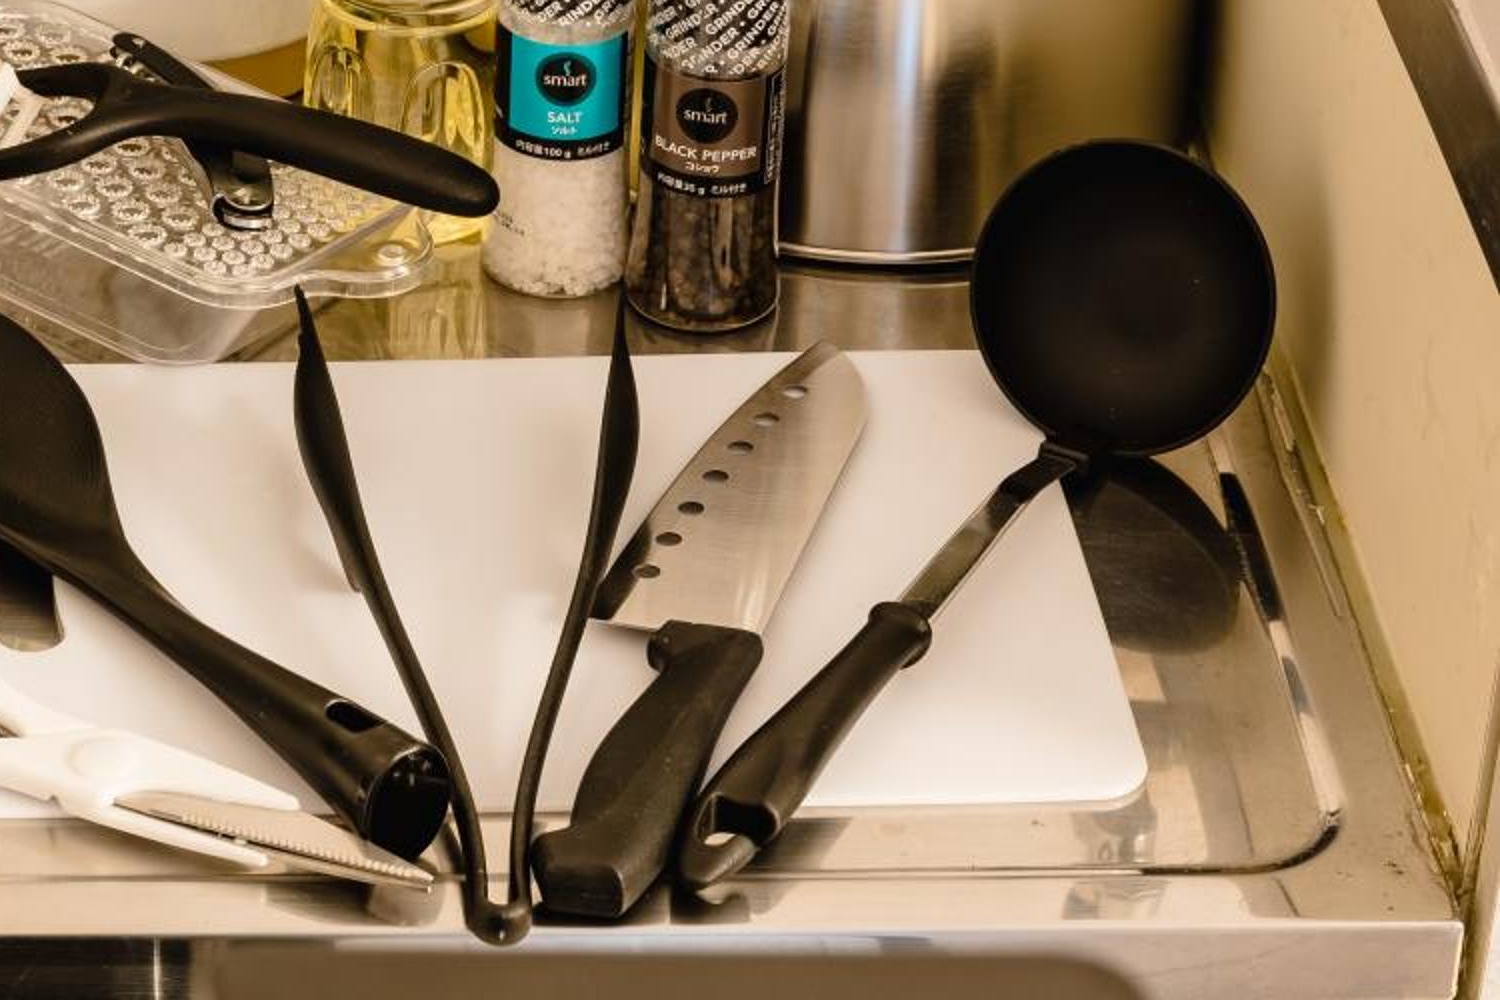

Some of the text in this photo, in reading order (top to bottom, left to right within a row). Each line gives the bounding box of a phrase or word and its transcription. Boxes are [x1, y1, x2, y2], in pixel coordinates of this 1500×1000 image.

[727, 1, 779, 59] GRINDER
[543, 73, 587, 87] smart
[547, 111, 583, 124] SALT
[684, 109, 728, 124] smart
[655, 135, 757, 162] BLACK PEPPER
